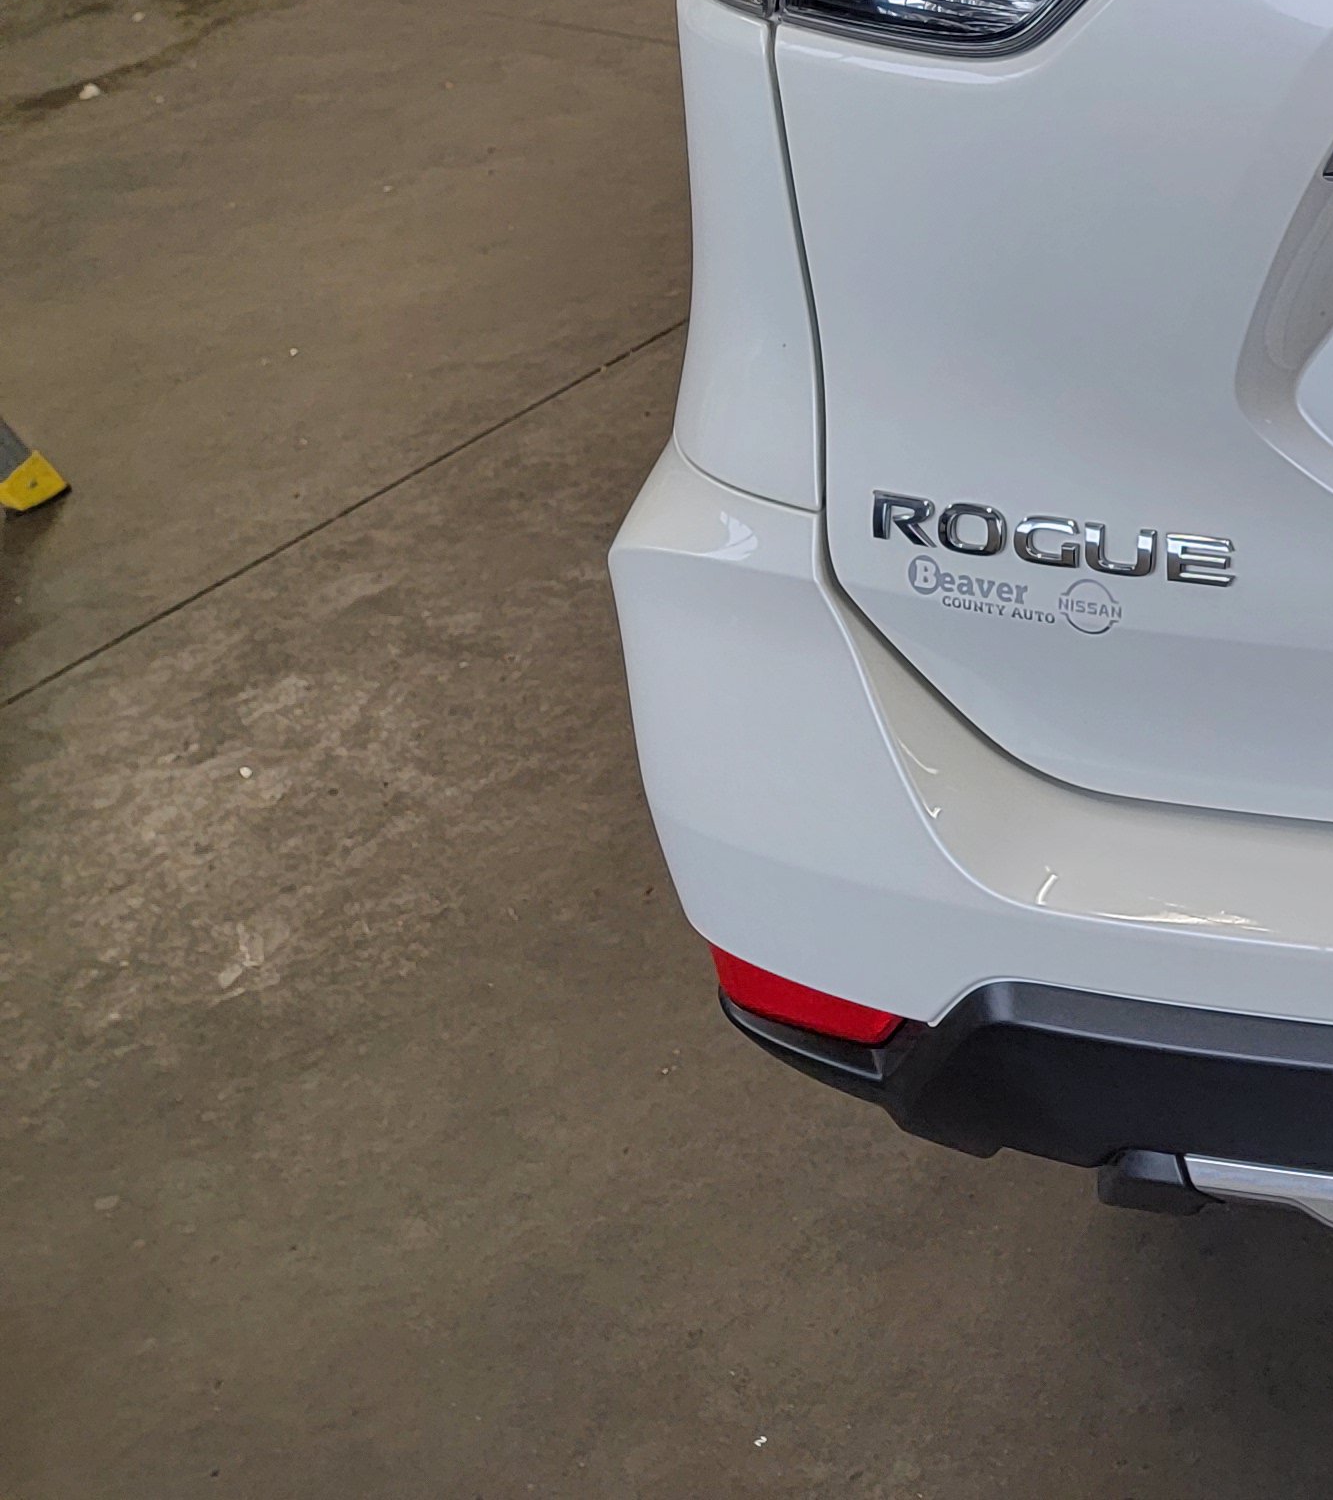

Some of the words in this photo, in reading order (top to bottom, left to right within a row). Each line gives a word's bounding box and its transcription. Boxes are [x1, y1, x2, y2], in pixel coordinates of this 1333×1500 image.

[873, 489, 1236, 587] ROGUE
[909, 555, 1028, 604] Beaver
[941, 595, 1006, 617] COUNTY
[1010, 605, 1056, 624] AUTO
[1057, 596, 1123, 620] NISSAN
